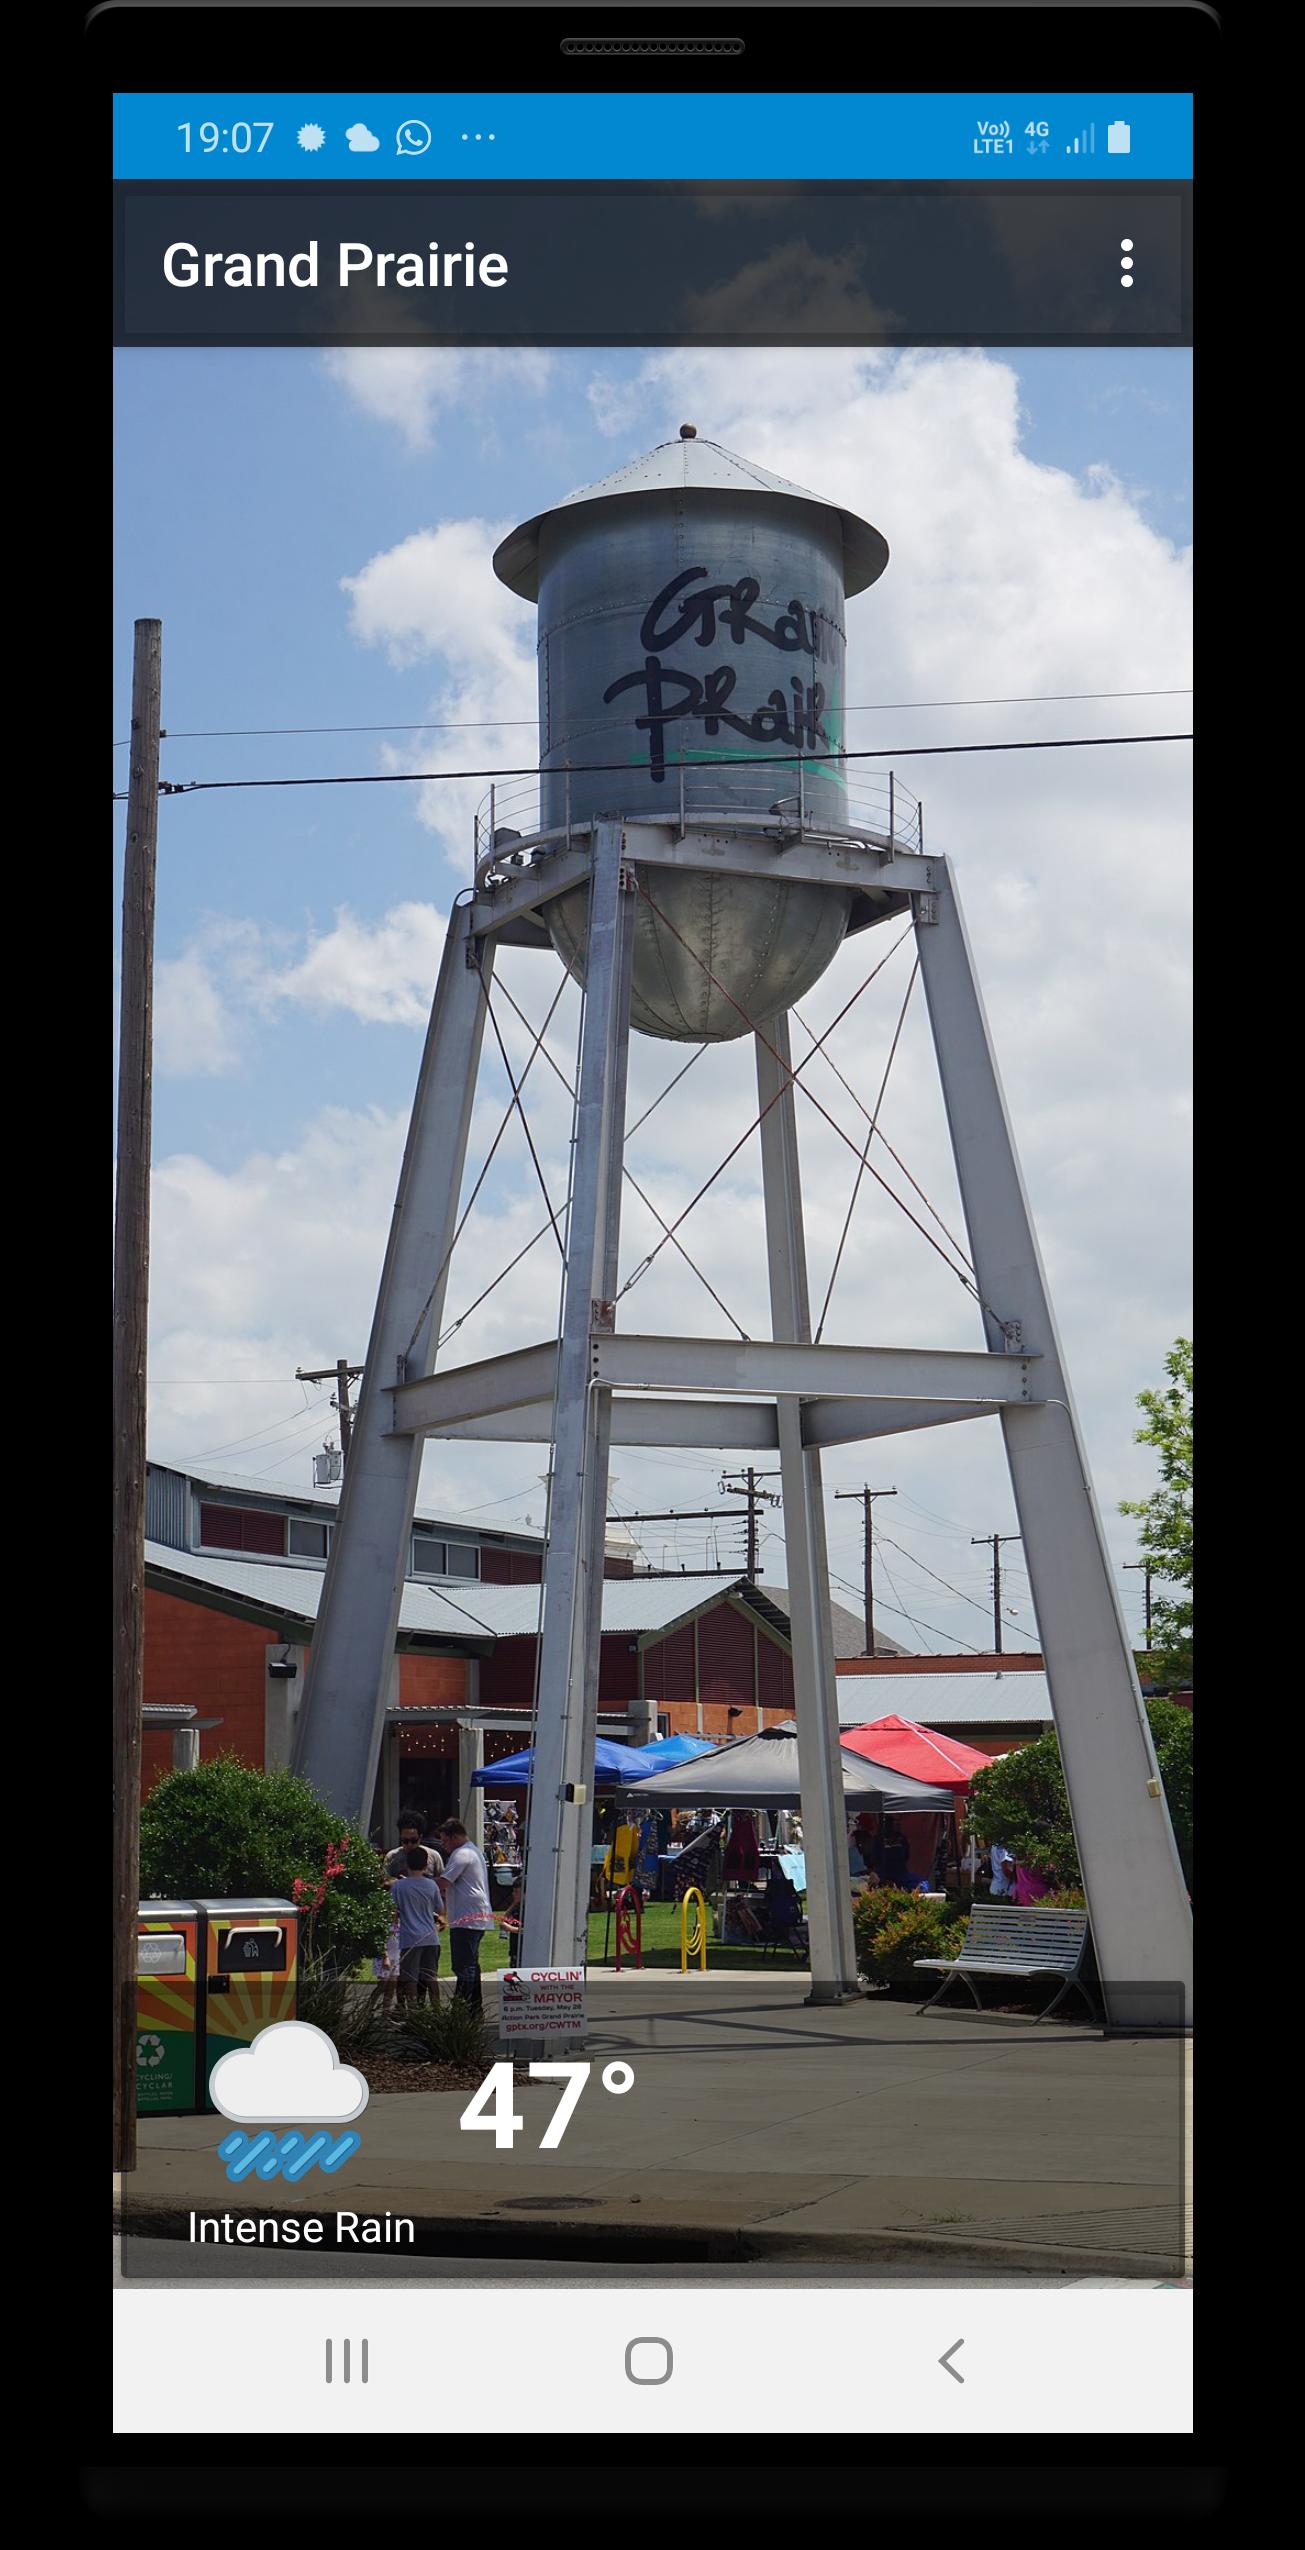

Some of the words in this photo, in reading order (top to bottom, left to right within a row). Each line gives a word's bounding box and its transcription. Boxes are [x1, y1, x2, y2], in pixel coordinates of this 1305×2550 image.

[177, 121, 274, 153] 19:07
[1024, 121, 1049, 137] 4G
[973, 138, 1013, 154] LTE1
[163, 240, 318, 288] Grand
[339, 241, 509, 288] Prairie
[531, 1971, 582, 1981] CYCLIN'
[534, 1993, 583, 2003] MAYOR
[506, 2021, 581, 2032] gptx.org/CWTM
[459, 2061, 636, 2149] 47°
[190, 2211, 324, 2243] Intense
[336, 2211, 414, 2243] Rain
